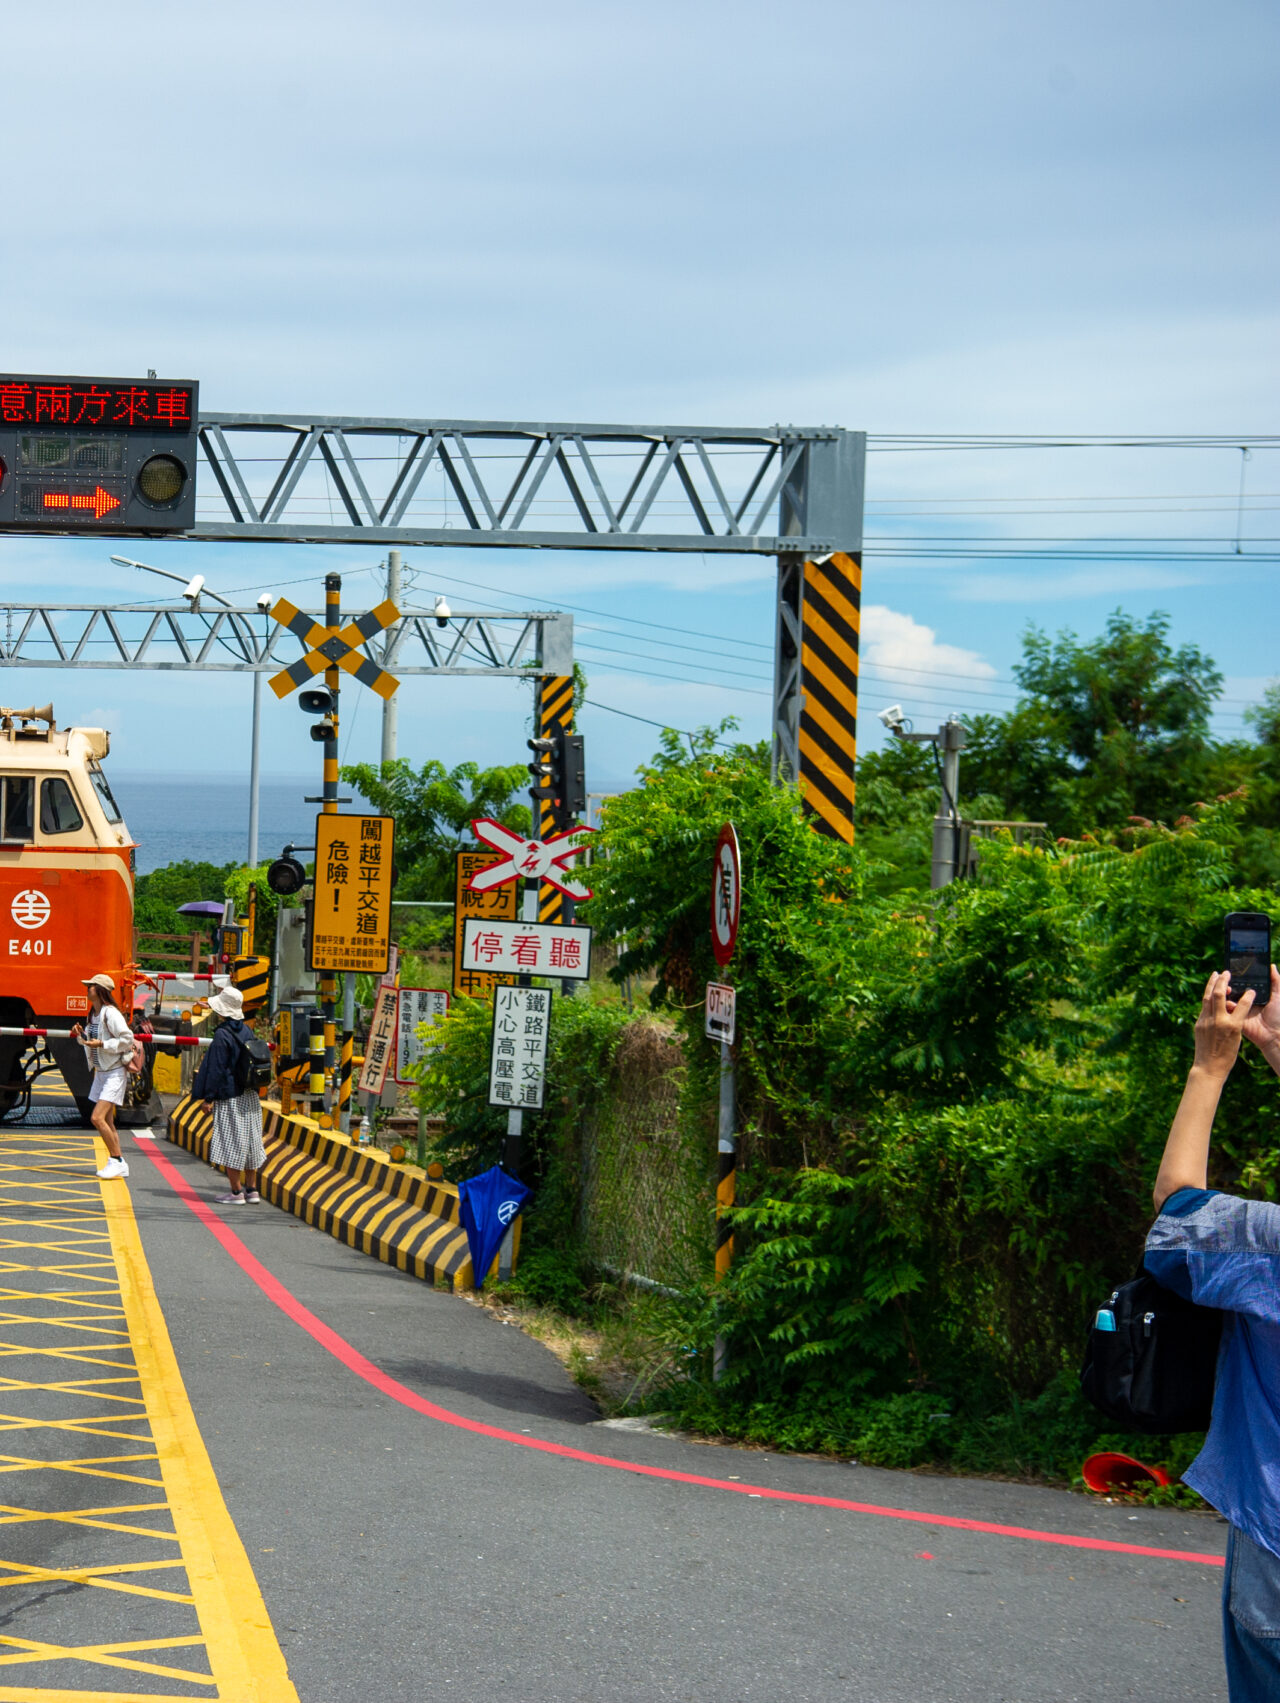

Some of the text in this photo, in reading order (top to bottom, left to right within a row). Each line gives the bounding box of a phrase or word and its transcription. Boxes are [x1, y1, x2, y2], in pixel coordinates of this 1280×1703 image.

[356, 820, 382, 935] 闖越平交道
[9, 939, 52, 955] E401
[472, 931, 582, 969] 停看聽
[365, 993, 397, 1086] 禁止通行
[494, 991, 520, 1102] 小心高壓電
[520, 993, 546, 1105] 鐵路平交道
